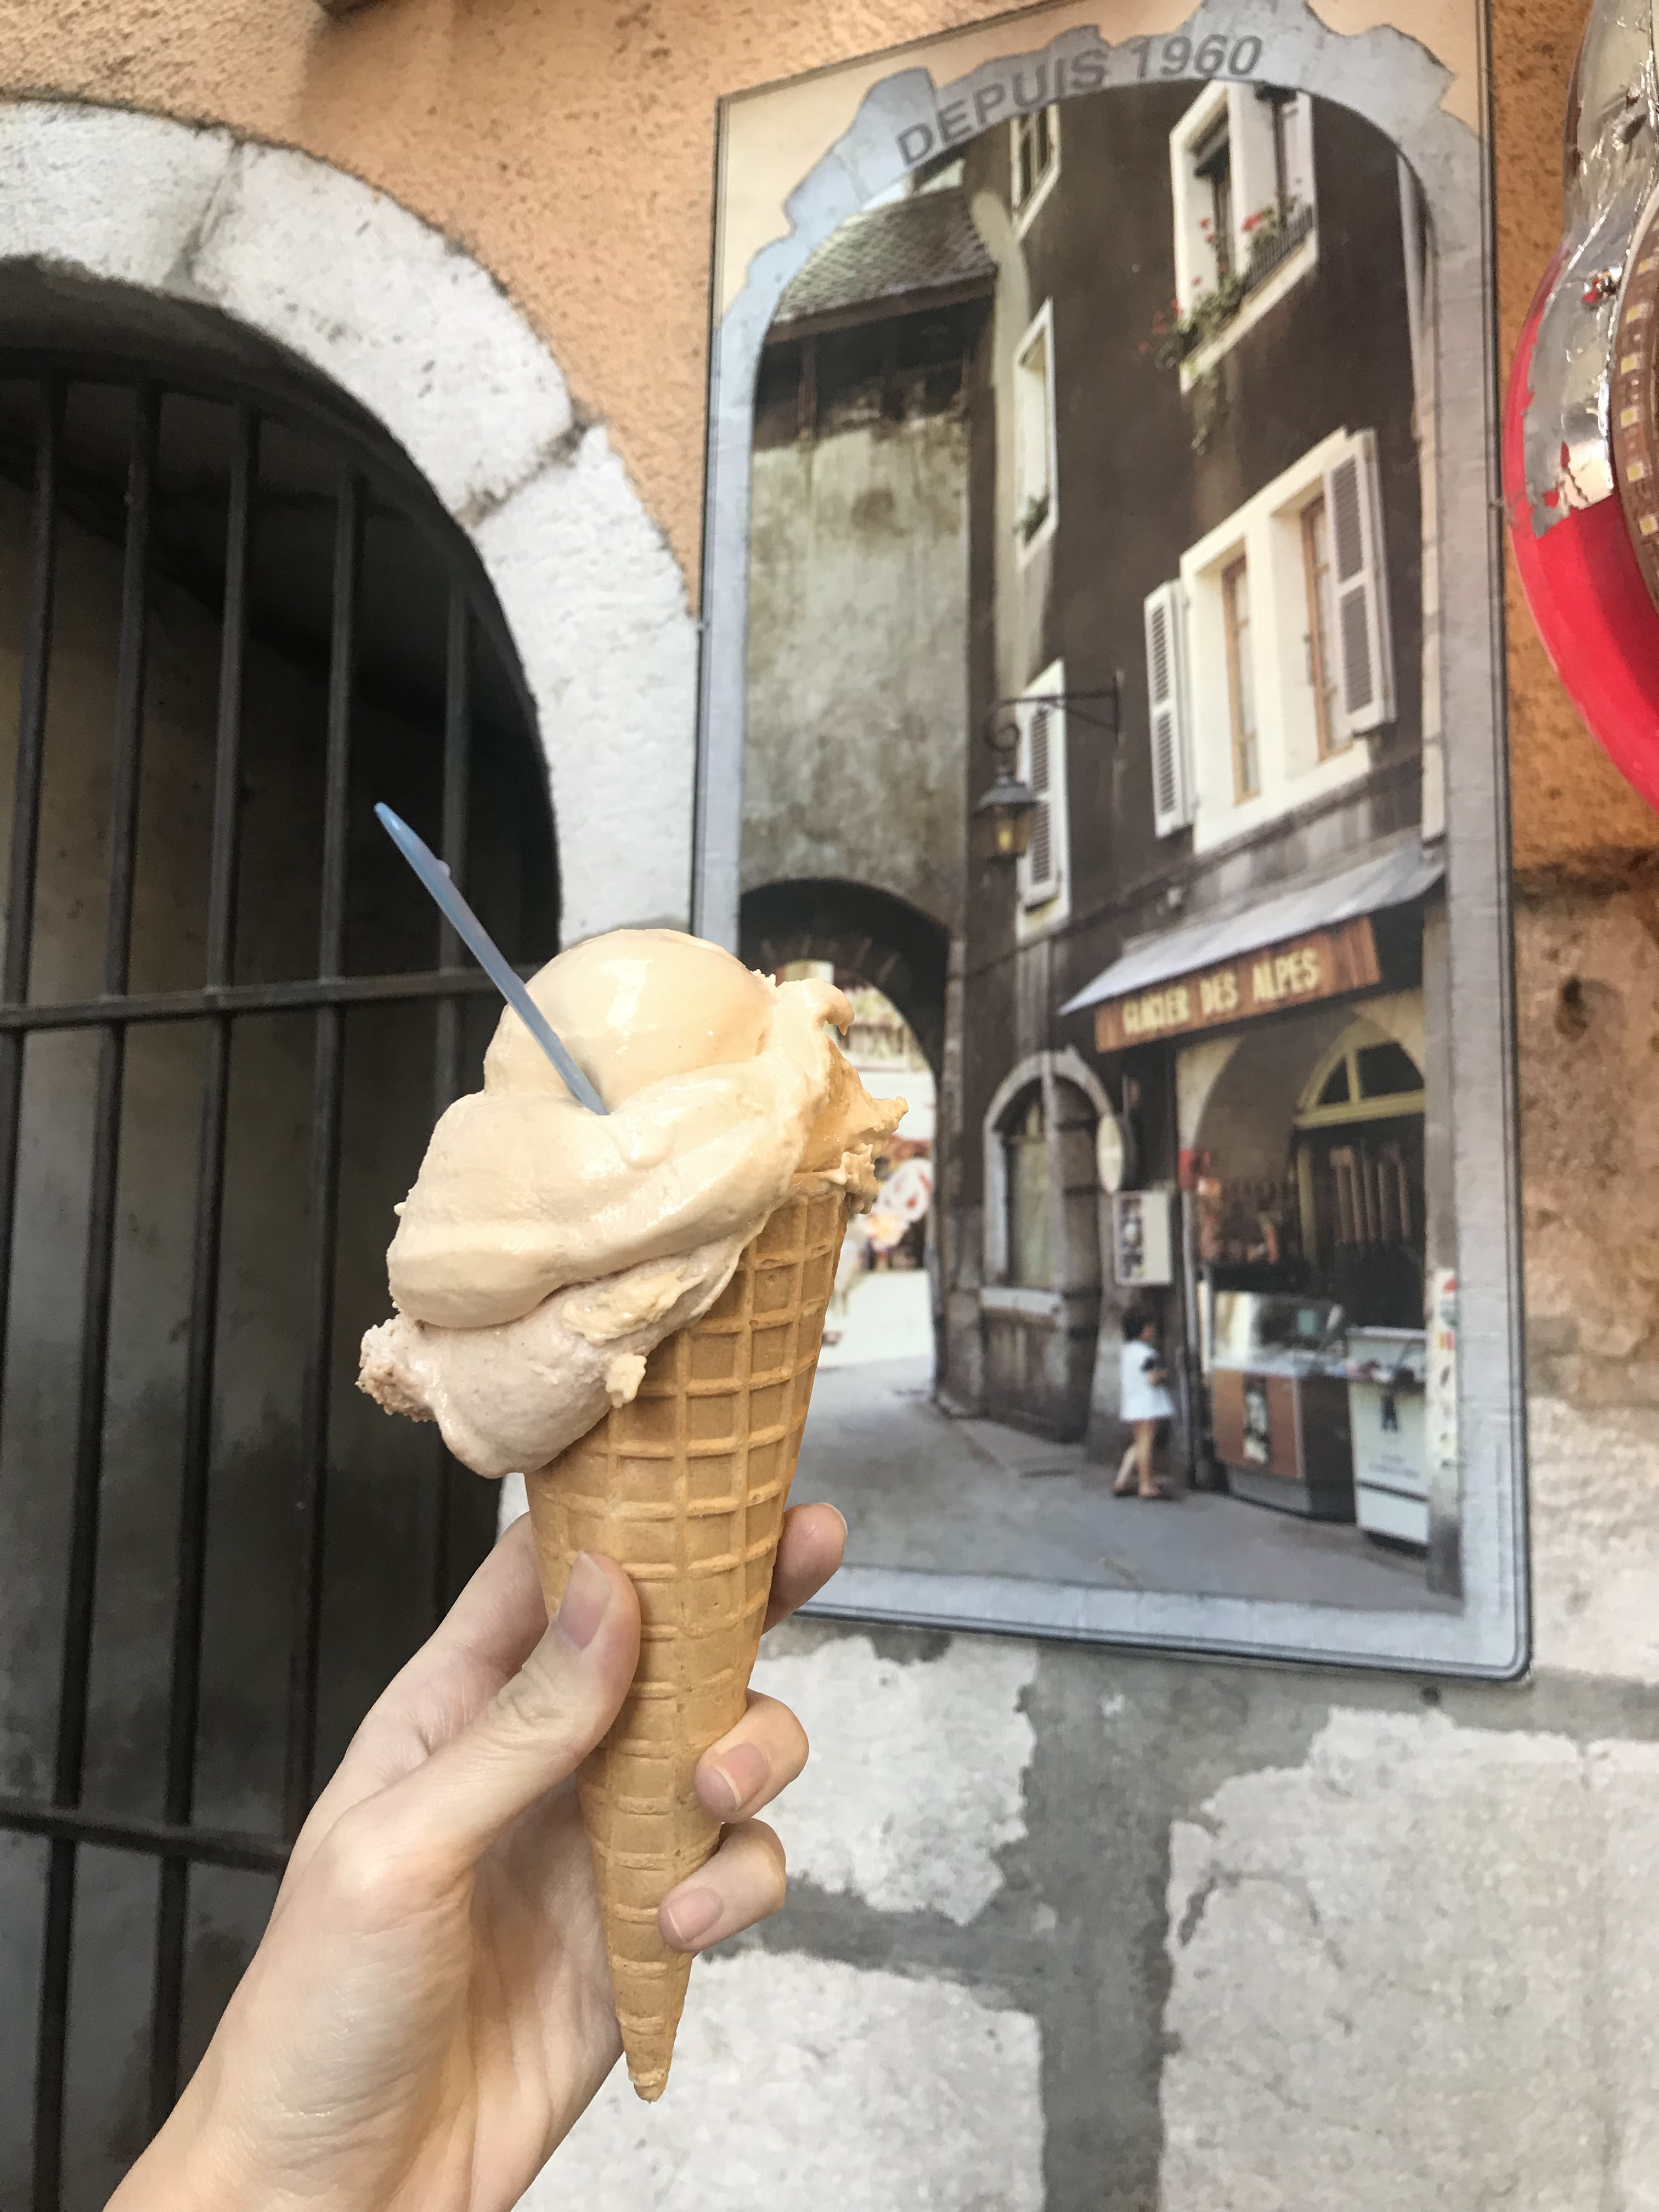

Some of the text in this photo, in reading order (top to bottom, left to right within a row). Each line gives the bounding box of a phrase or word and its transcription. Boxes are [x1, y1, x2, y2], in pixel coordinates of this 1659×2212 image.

[897, 35, 1262, 166] DEPUIS 1960
[1200, 970, 1238, 1014] DES
[1252, 949, 1319, 1001] ALPES
